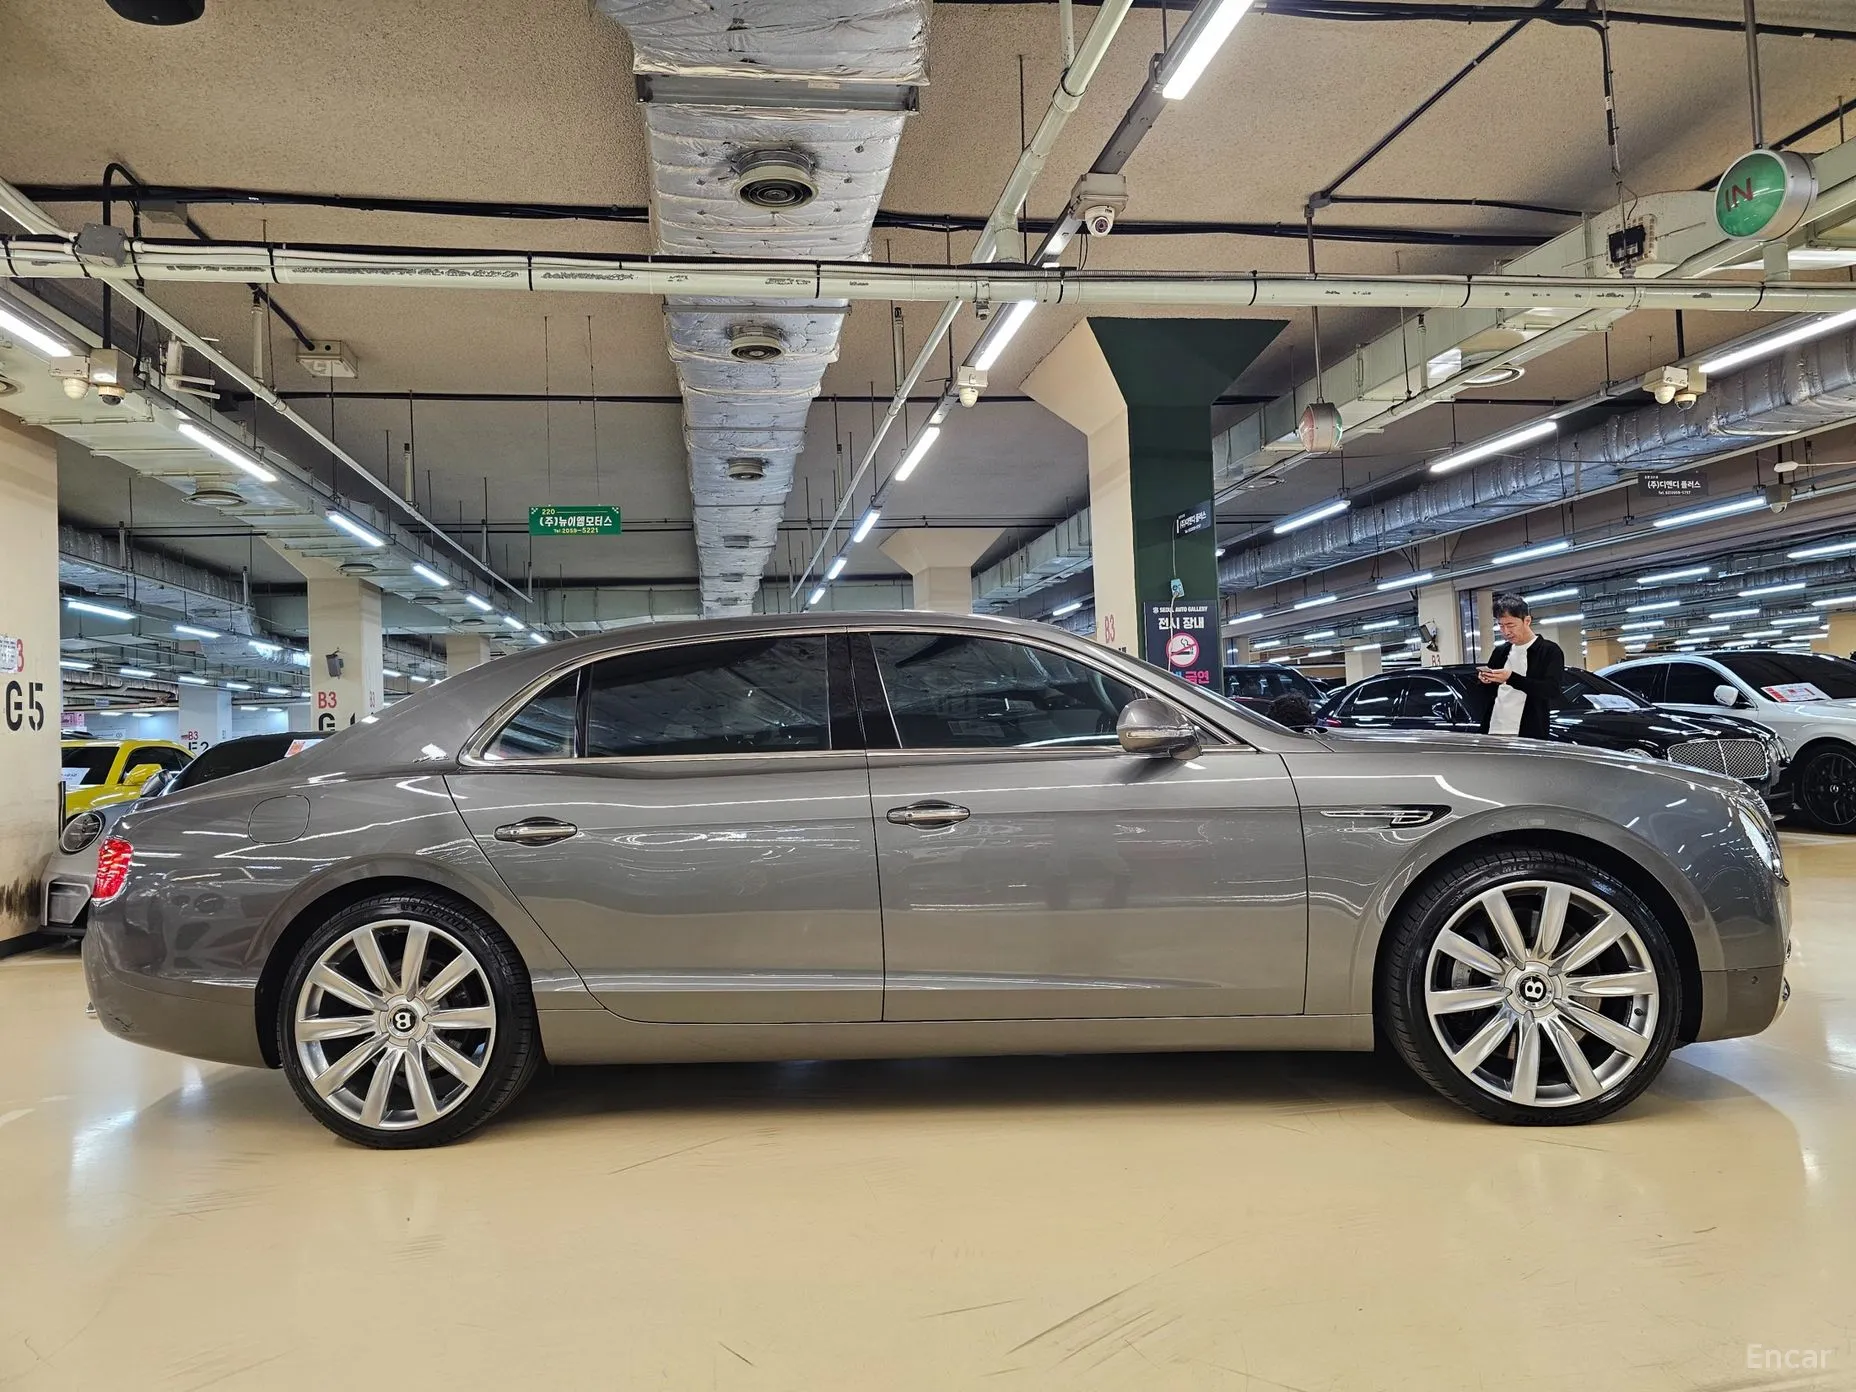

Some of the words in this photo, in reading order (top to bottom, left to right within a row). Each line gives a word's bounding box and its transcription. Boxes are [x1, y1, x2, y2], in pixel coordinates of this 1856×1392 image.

[1725, 177, 1753, 212] IN
[1187, 605, 1208, 613] GALLERY
[1158, 617, 1180, 630] 전시
[1182, 616, 1205, 629] 장내
[5, 680, 45, 732] G5
[318, 691, 337, 709] B3
[188, 730, 199, 741] B3
